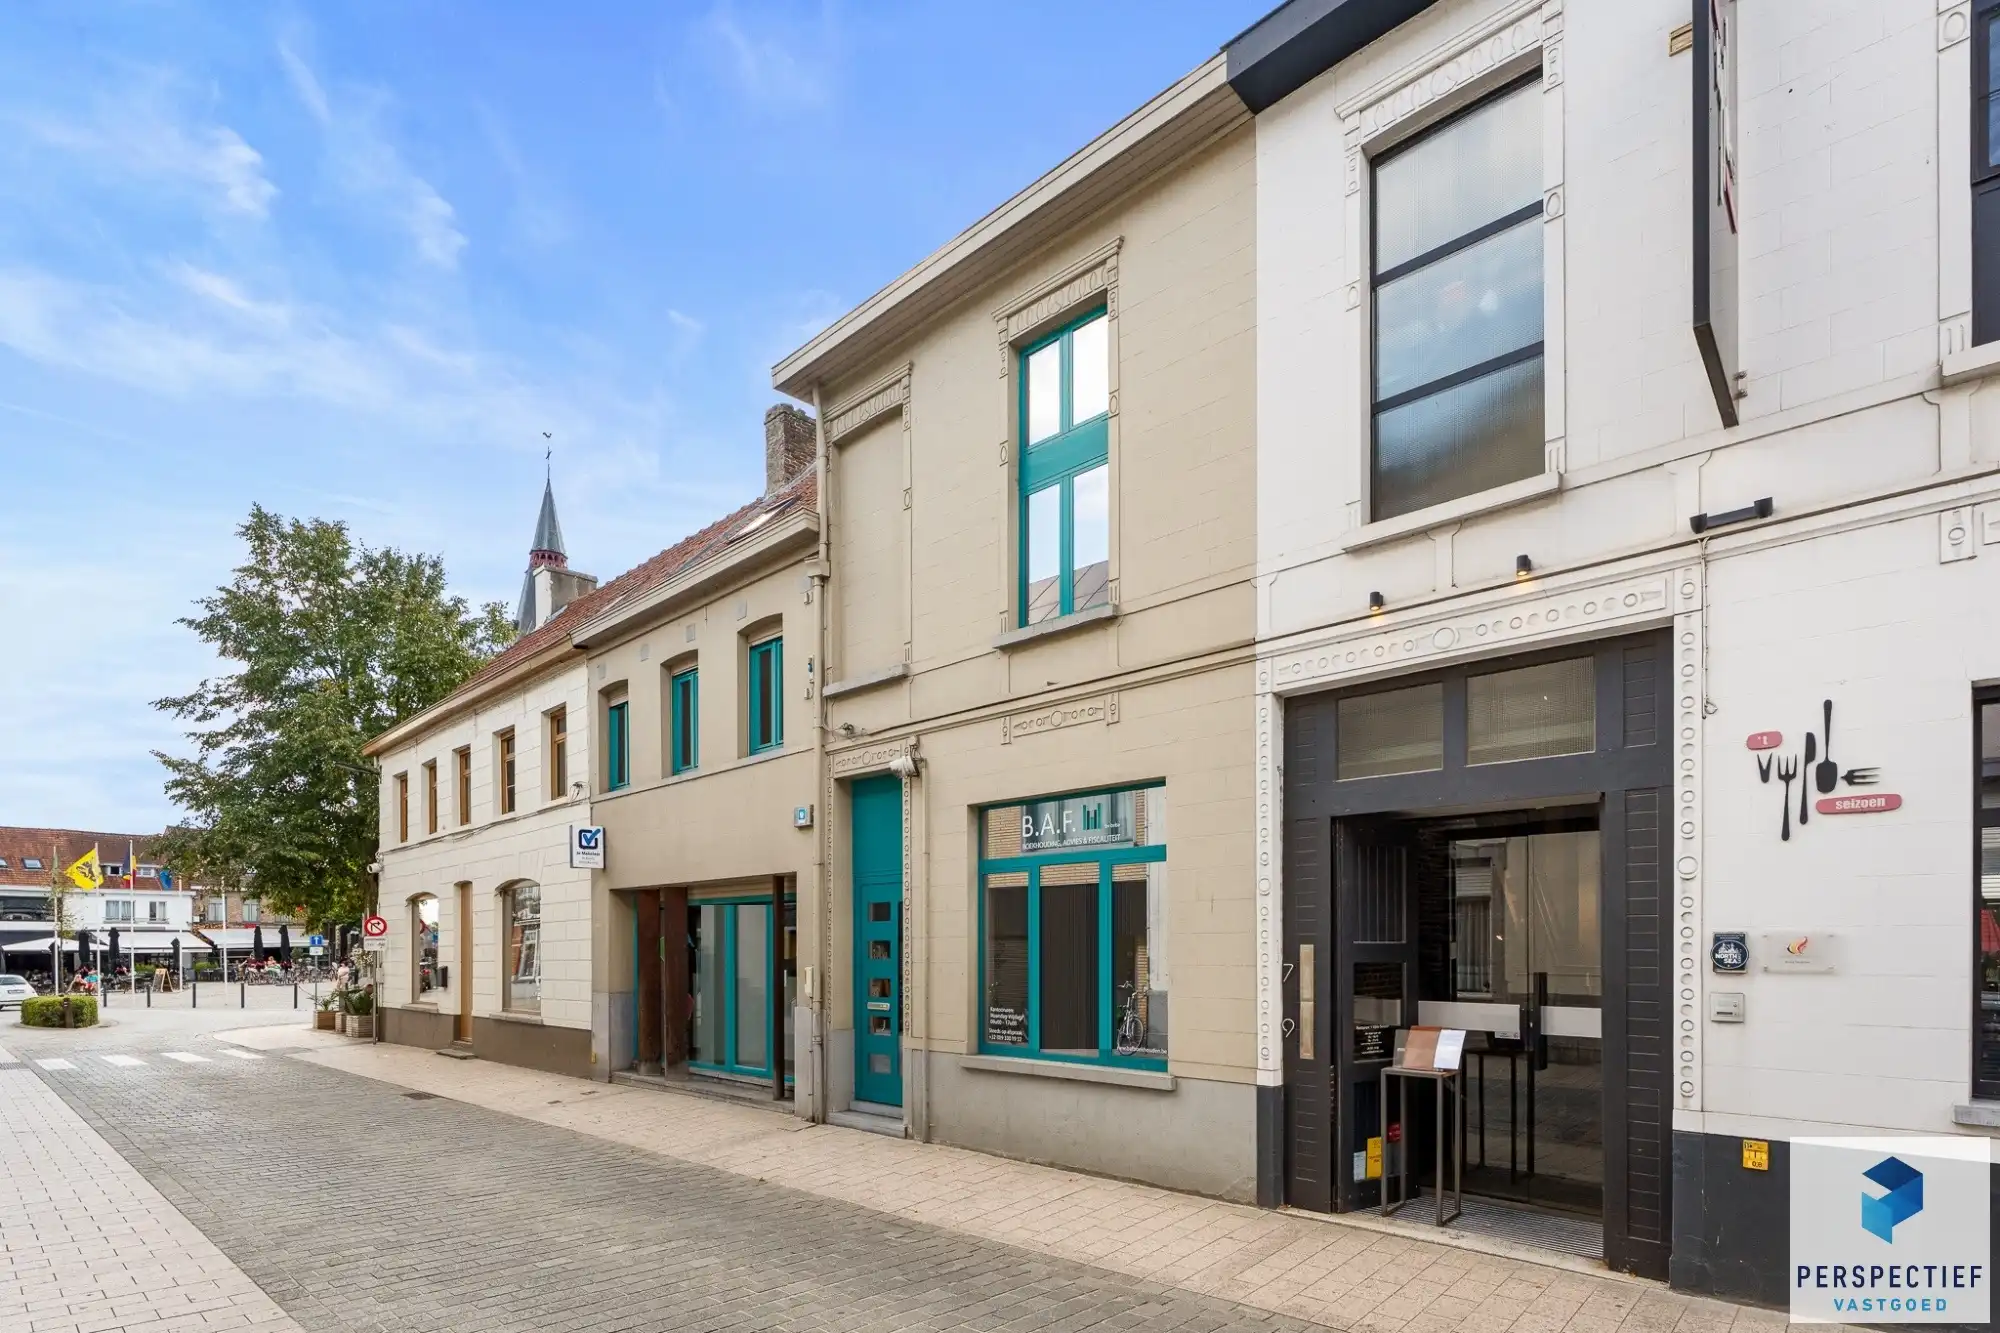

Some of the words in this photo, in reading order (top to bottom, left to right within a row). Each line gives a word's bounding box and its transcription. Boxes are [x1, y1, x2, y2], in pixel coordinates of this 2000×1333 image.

[1835, 796, 1886, 810] seizoen
[1022, 810, 1076, 838] B.A.F.
[1283, 963, 1294, 983] 7
[1281, 1017, 1295, 1038] 9
